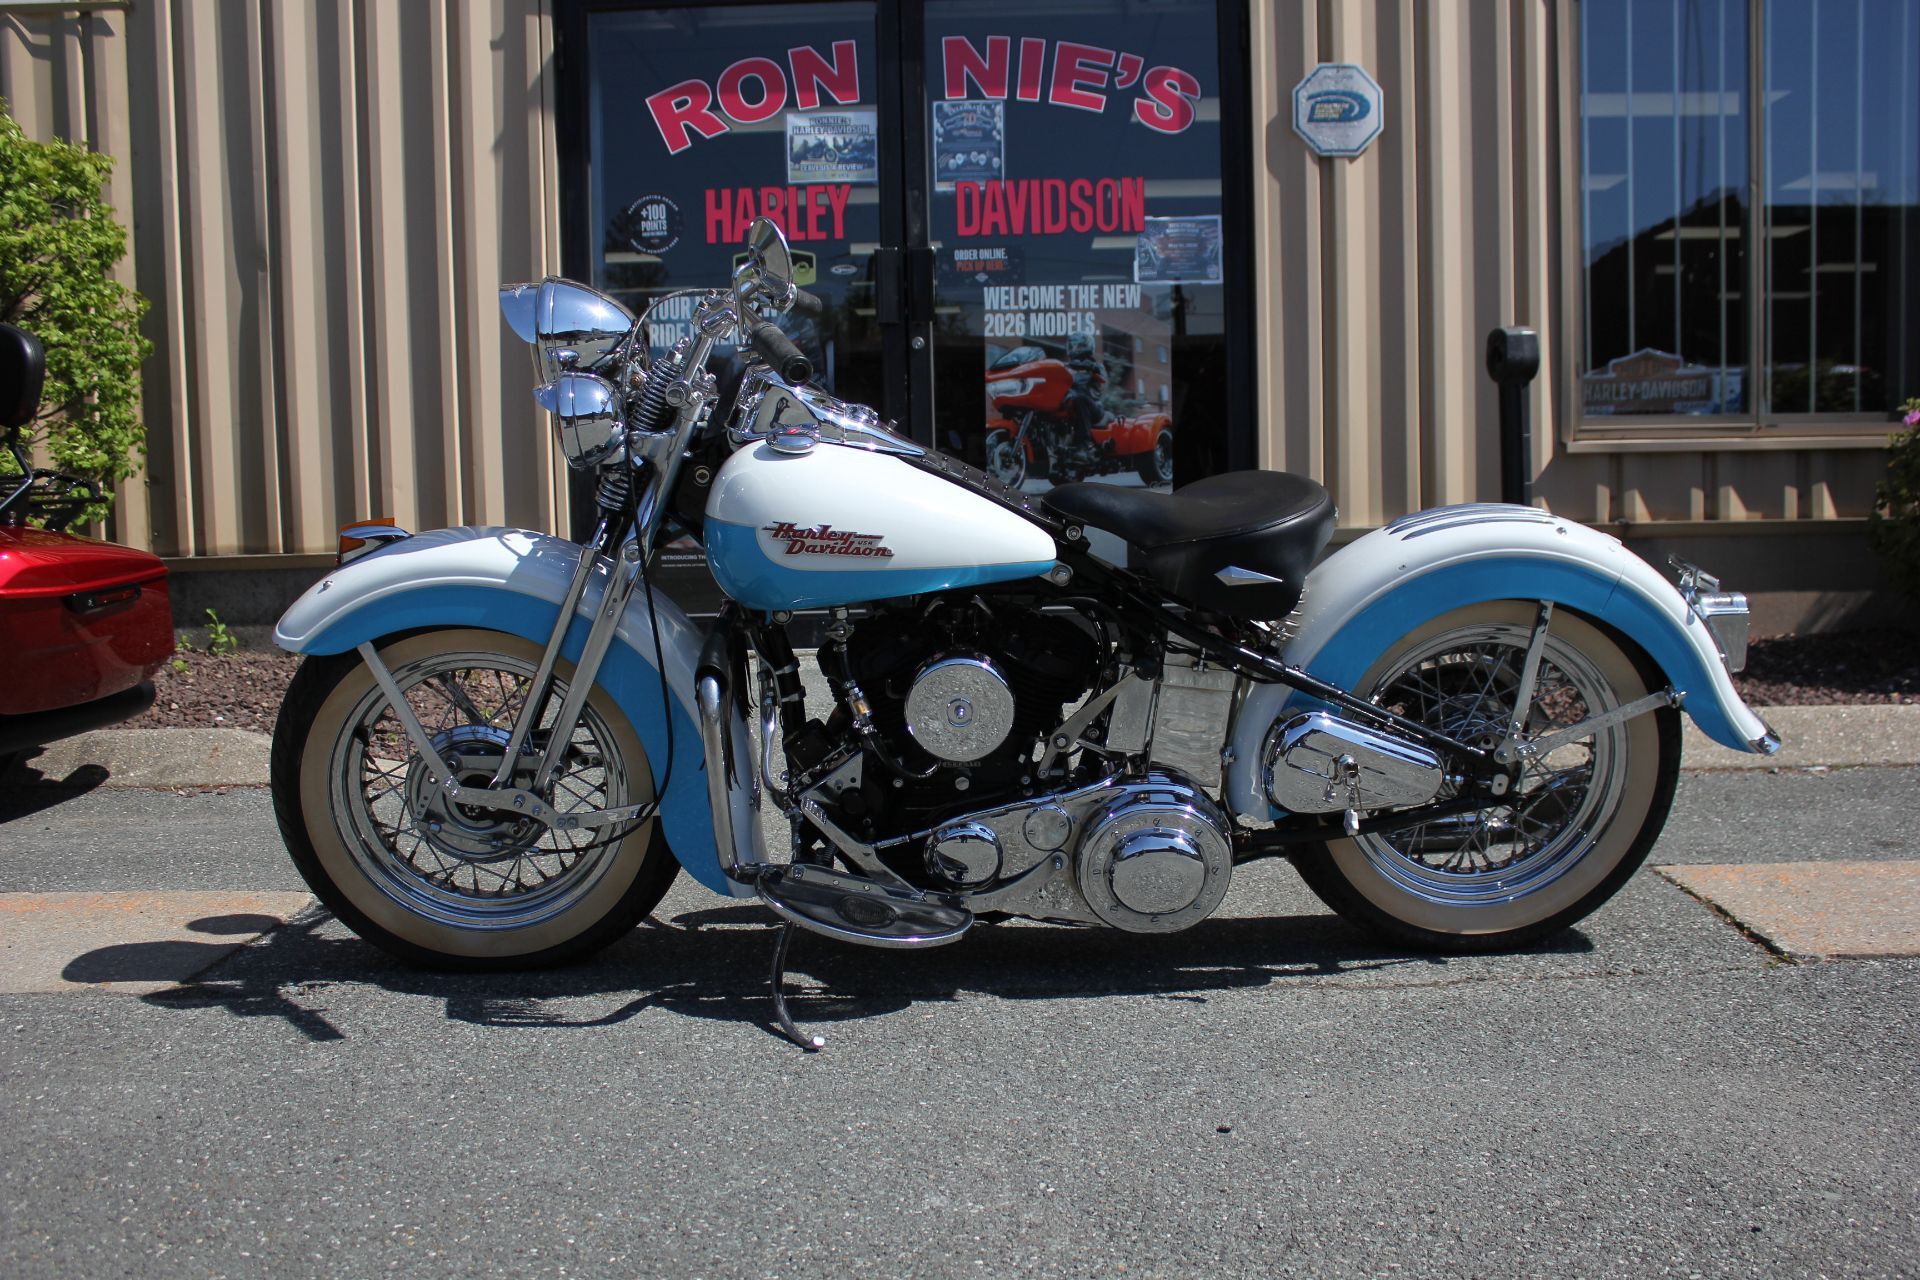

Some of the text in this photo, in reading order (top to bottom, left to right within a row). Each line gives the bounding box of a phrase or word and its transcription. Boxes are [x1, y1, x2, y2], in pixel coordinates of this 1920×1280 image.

[645, 35, 1201, 155] RON NIE'S
[641, 204, 666, 220] +100
[705, 176, 1146, 244] HARLEY DAVIDSON
[641, 220, 667, 231] POINTS
[954, 248, 1008, 260] ORDER ONLINE.
[956, 261, 973, 271] PICK
[975, 260, 985, 271] UP
[984, 284, 1141, 310] WELCOME THE NEW
[984, 312, 1100, 337] 2026 MODELS.
[763, 521, 884, 545] Harley
[785, 538, 895, 557] Davidson
